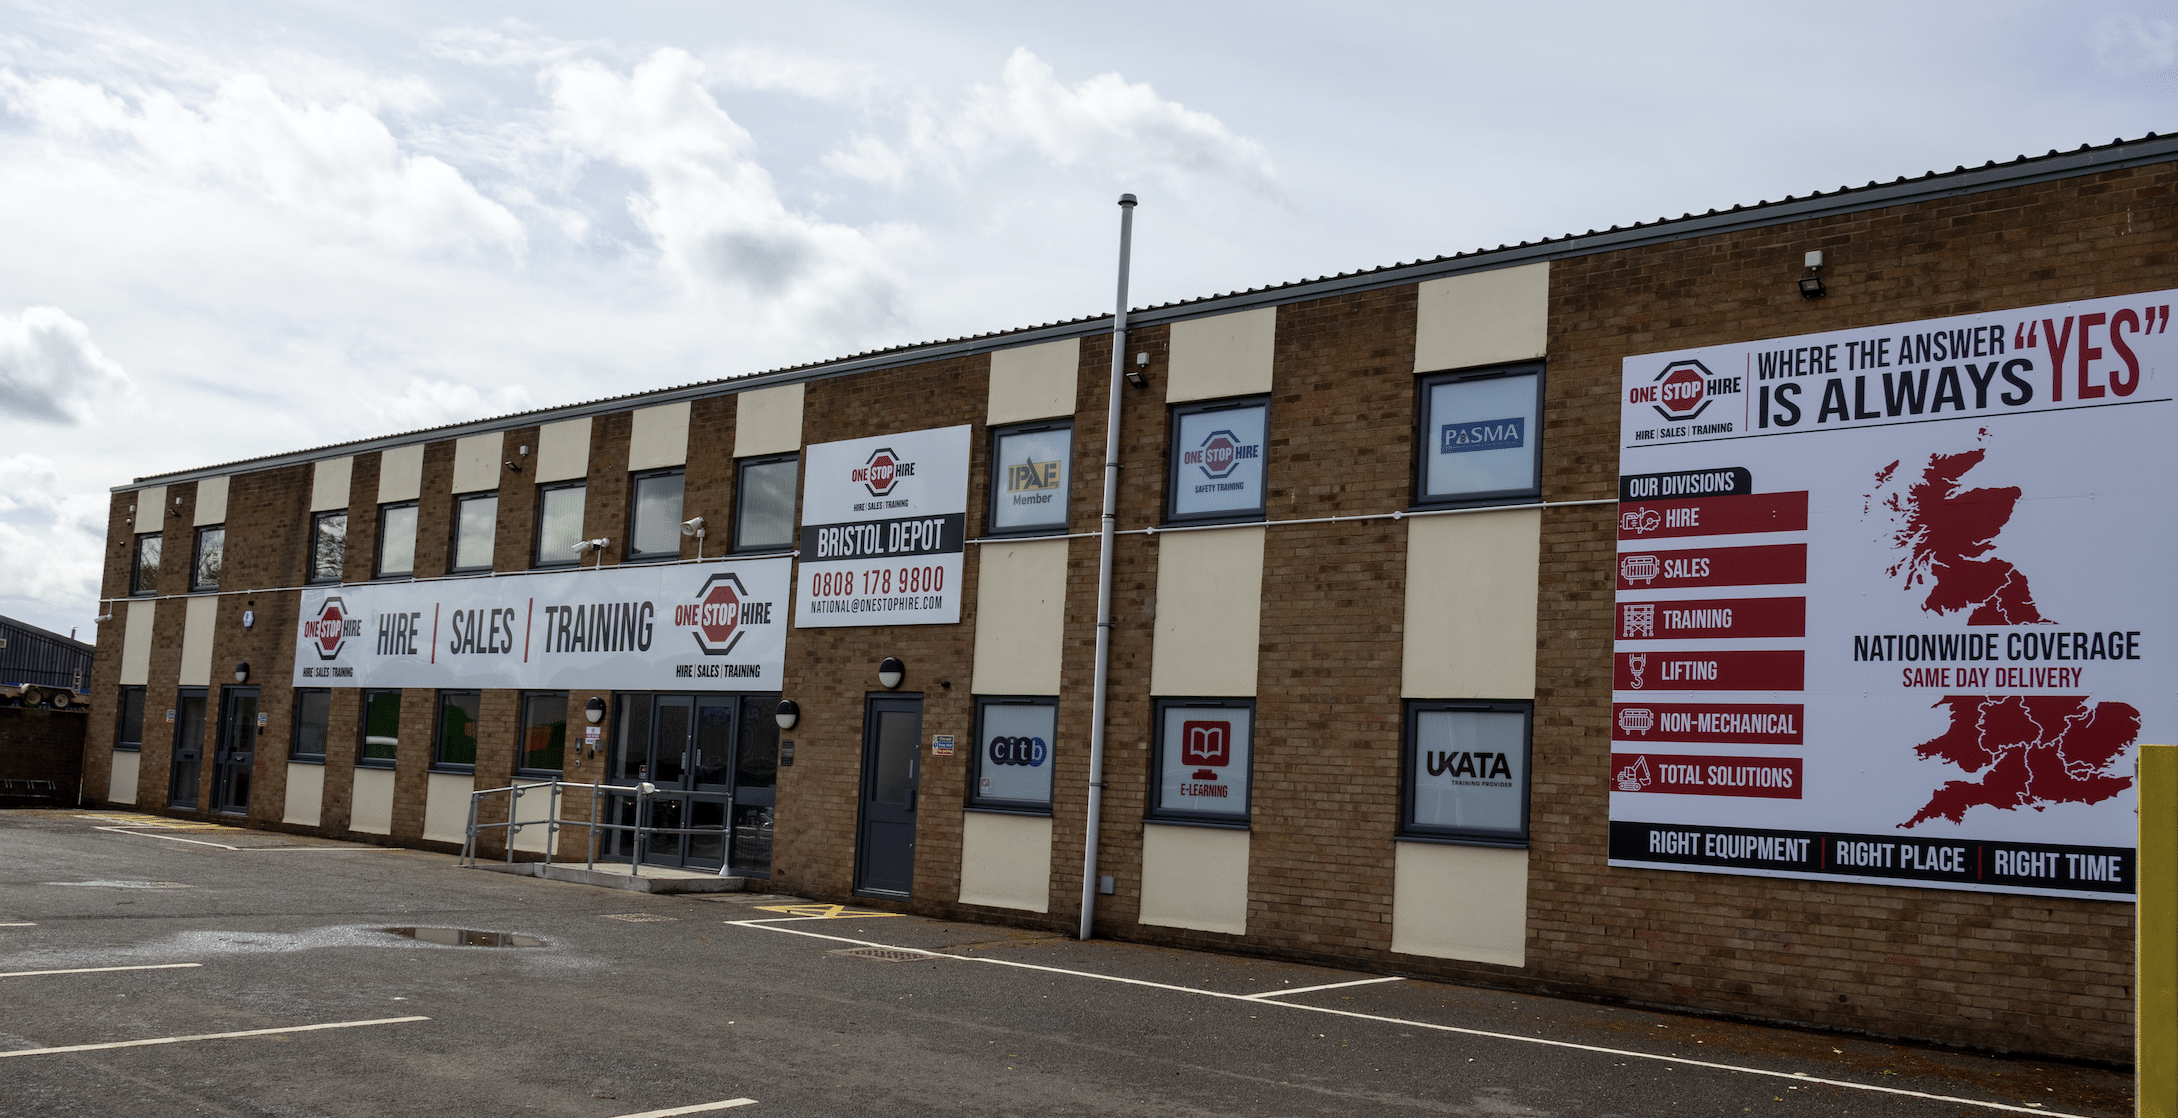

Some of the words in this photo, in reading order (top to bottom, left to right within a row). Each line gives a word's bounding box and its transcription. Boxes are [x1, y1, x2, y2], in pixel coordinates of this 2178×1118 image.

[1758, 345, 1837, 380] WHERE
[1845, 338, 1891, 370] THE
[1898, 325, 2005, 366] ANSWER
[1630, 386, 1658, 404] ONE
[1664, 381, 1701, 400] STOP
[1707, 376, 1741, 396] HIRE
[1758, 382, 1802, 429] IS
[1818, 358, 2034, 424] ALWAYS
[1446, 424, 1519, 445] PASMA
[1636, 429, 1655, 440] HIRE
[1660, 427, 1686, 438] SALES
[1691, 423, 1733, 435] TRAINING
[1184, 450, 1203, 464] ONE
[1206, 447, 1232, 462] STOP
[1235, 445, 1259, 459] HIRE
[852, 468, 868, 482] ONE
[871, 465, 893, 480] STOP
[895, 462, 915, 478] HIRE
[1009, 457, 1056, 490] IPAF
[1195, 484, 1216, 493] SAFETY
[1217, 481, 1244, 491] TRAINING
[1630, 478, 1658, 497] OUR
[1662, 472, 1735, 495] DIVISIONS
[854, 503, 865, 511] HIRE
[868, 501, 882, 510] SALES
[885, 499, 909, 509] TRAINING
[1013, 493, 1052, 505] Member
[1666, 507, 1700, 528] HIRE
[817, 524, 884, 558] BRISTOL
[889, 518, 945, 553] DEPOT
[1664, 558, 1710, 579] SALES
[812, 571, 854, 597] 0808
[863, 569, 891, 595] 178
[899, 566, 944, 593] 9800
[674, 604, 700, 626] ONE
[703, 603, 737, 626] STOP
[740, 602, 772, 625] HIRE
[811, 596, 942, 613] NATIONAL@ONESTOPHIRE.COM
[304, 621, 320, 638] ONE
[321, 620, 341, 638] STOP
[342, 620, 362, 637] HIRE
[377, 612, 421, 655] HIRE
[450, 608, 515, 655] SALES
[545, 601, 654, 653] TRAINING
[1663, 609, 1732, 630] TRAINING
[1854, 633, 1999, 661] NATIONWIDE
[2006, 631, 2141, 661] COVERAGE
[303, 667, 314, 677] HIRE
[315, 667, 330, 677] SALES
[332, 667, 353, 677] TRAINING
[676, 664, 693, 678] HIRE
[697, 664, 720, 678] SALES
[724, 664, 761, 678] TRAINING
[1662, 661, 1718, 681] LIFTING
[1902, 667, 1950, 688] SAME
[1956, 667, 1990, 687] DAY
[1995, 667, 2083, 688] DELIVERY
[1660, 712, 1797, 734] NON-MECHANICAL
[993, 738, 1043, 761] citb
[1427, 751, 1512, 779] UKATA
[1659, 764, 1704, 784] TOTAL
[1708, 766, 1793, 788] SOLUTIONS
[1181, 783, 1228, 798] E-LEARNING
[1649, 830, 1701, 856] RIGHT
[1705, 833, 1811, 863] EQUIPMENT
[1836, 840, 1895, 868] RIGHT
[1900, 844, 1966, 873] PLACE
[1994, 849, 2060, 879] RIGHT
[2065, 853, 2122, 882] TIME
